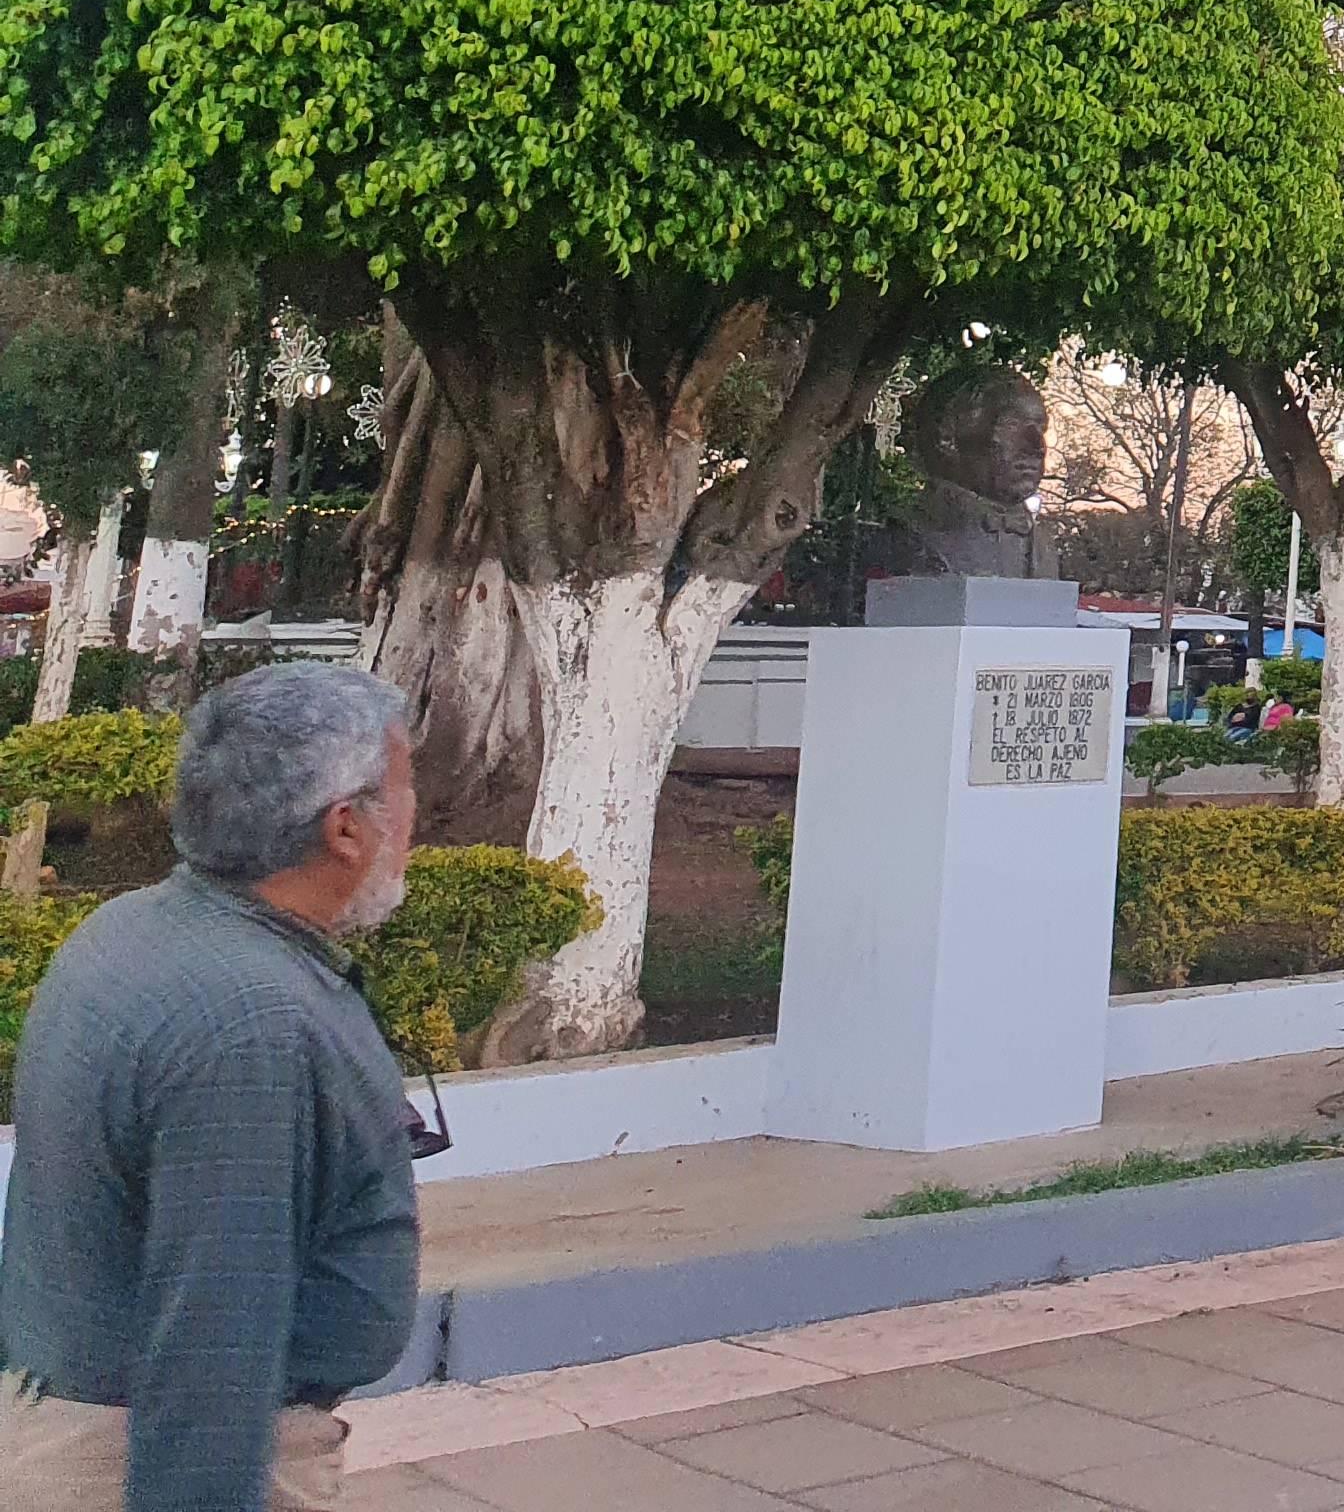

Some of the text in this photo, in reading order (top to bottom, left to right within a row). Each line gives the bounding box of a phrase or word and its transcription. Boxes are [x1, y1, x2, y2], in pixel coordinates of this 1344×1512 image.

[975, 673, 1110, 691] BENITO JUAREZ GARCIA
[1006, 691, 1094, 709] 21 MARZO 1806
[1004, 709, 1092, 726] 18 JULIO 1872
[992, 726, 1089, 745] EL RESPETO AL
[990, 744, 1088, 762] DERECHO AJENO
[1005, 762, 1073, 781] ES LA PAZ
